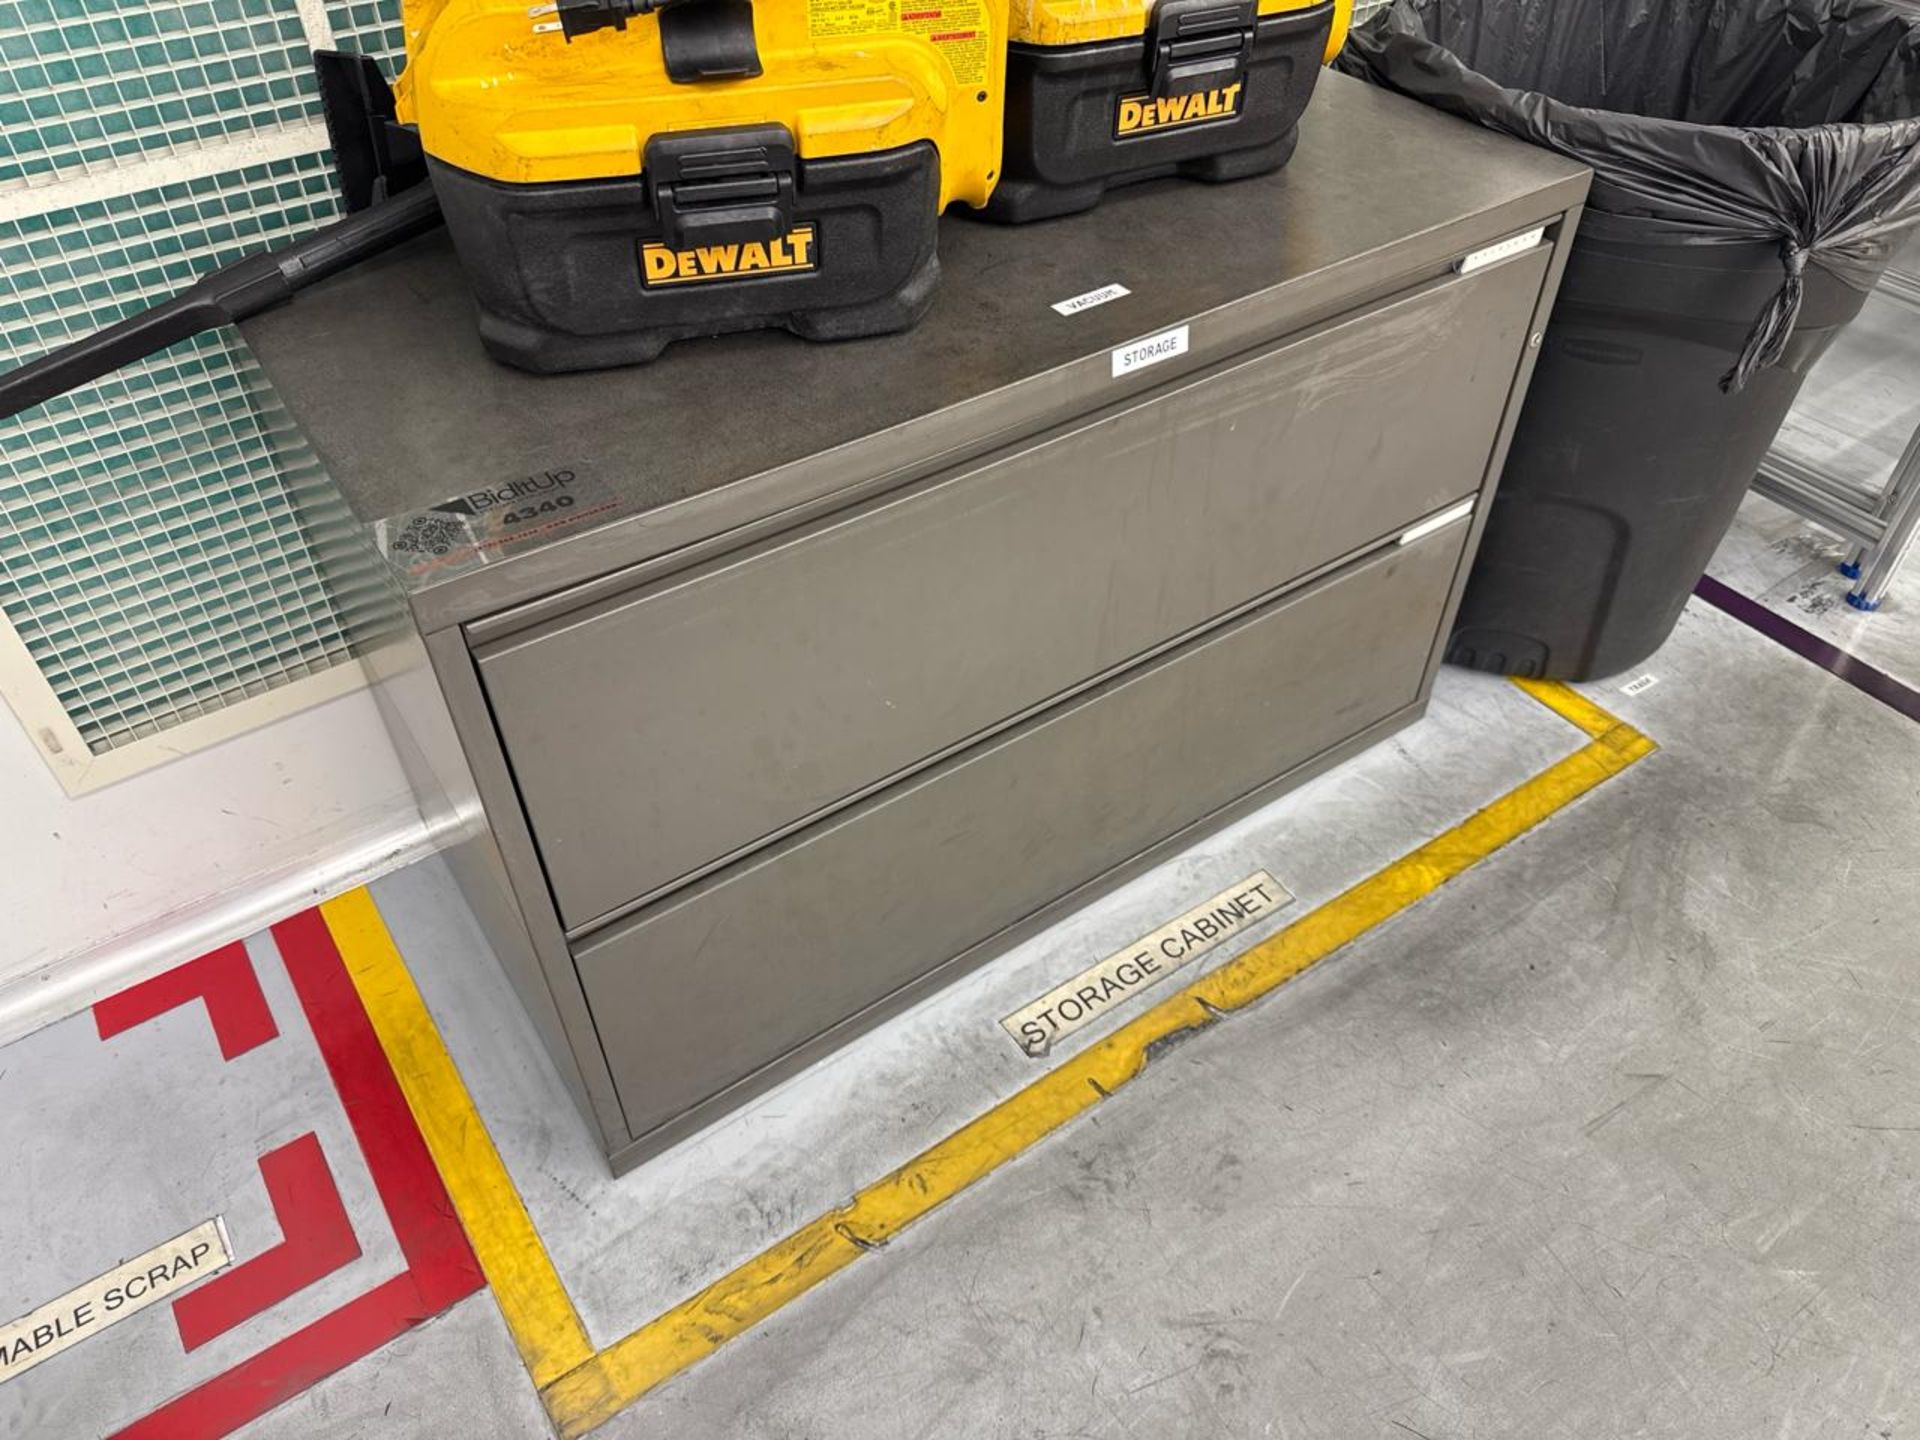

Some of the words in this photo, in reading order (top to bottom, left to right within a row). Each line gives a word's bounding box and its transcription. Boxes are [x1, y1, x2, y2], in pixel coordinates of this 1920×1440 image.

[1066, 288, 1118, 309] VACUUM
[1124, 336, 1177, 366] STORAGE
[503, 495, 574, 525] 4340
[1020, 951, 1163, 1046] STORAGE
[1161, 883, 1274, 959] CABINET
[104, 1242, 210, 1312] SCRAP
